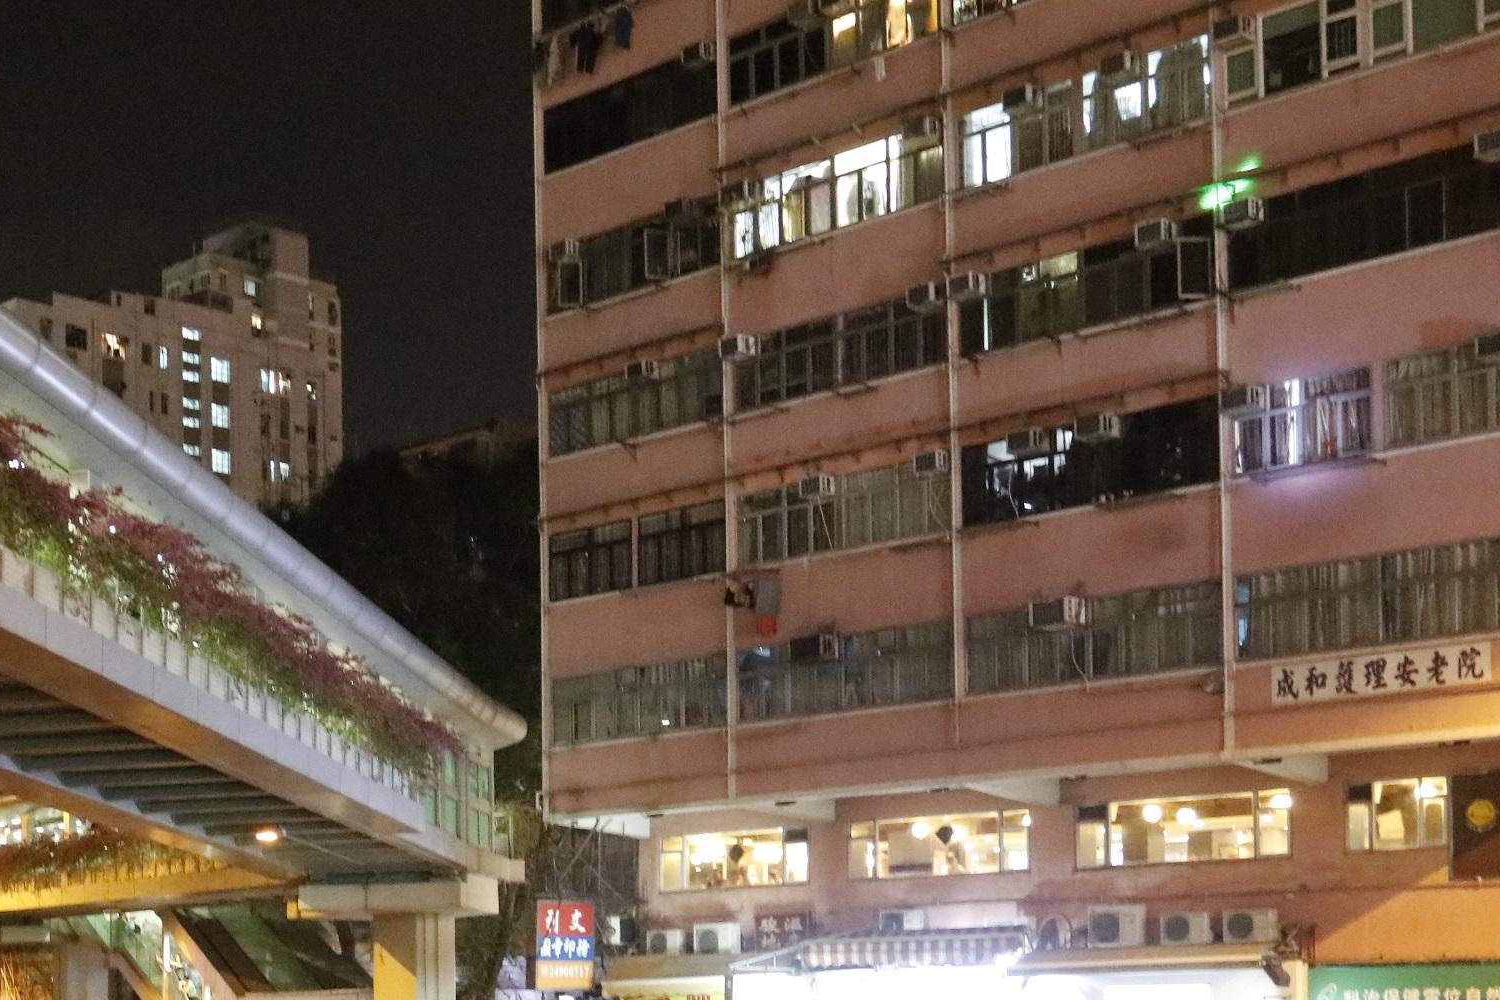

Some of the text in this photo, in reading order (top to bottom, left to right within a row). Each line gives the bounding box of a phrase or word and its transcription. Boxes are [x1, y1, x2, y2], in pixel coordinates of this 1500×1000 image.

[1276, 647, 1485, 699] 成和護理安老院
